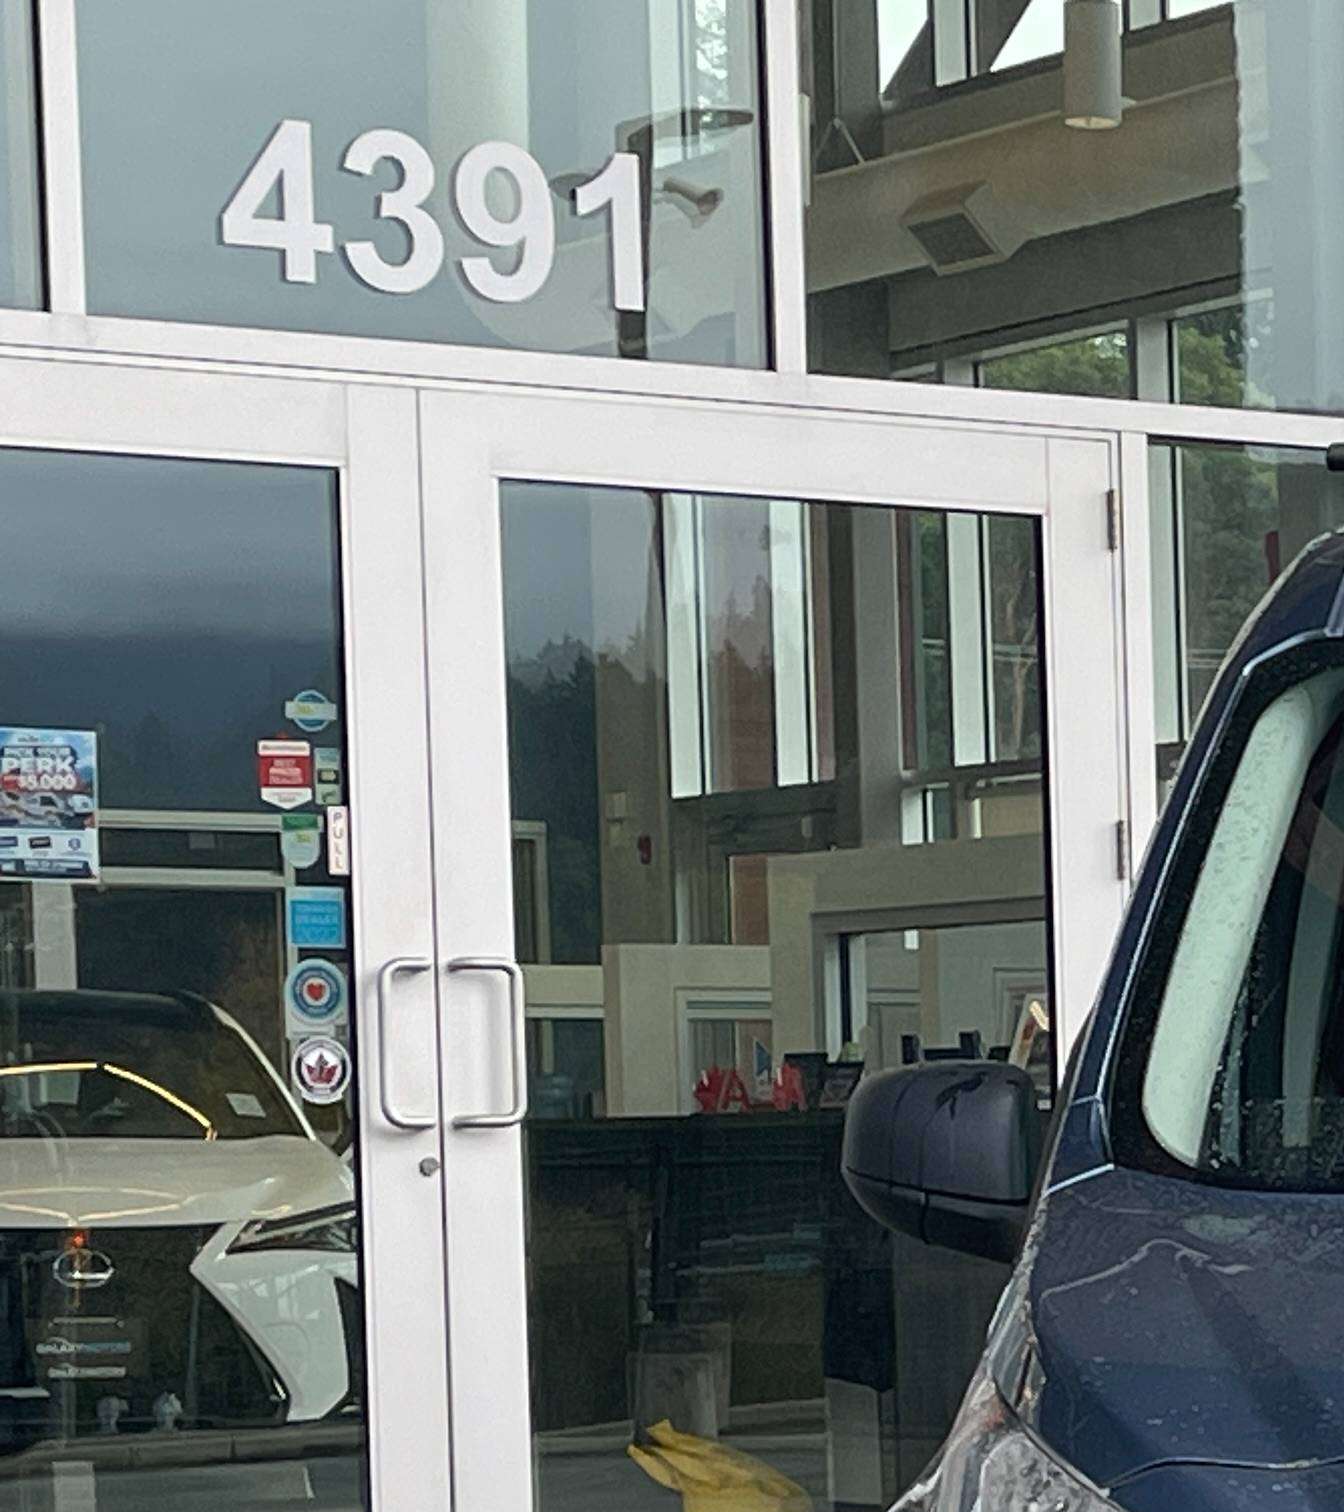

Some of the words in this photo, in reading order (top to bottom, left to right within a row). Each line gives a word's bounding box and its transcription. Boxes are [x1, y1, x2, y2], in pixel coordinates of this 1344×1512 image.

[221, 119, 646, 312] 4391
[2, 757, 74, 775] PERK
[332, 811, 344, 869] PULL
